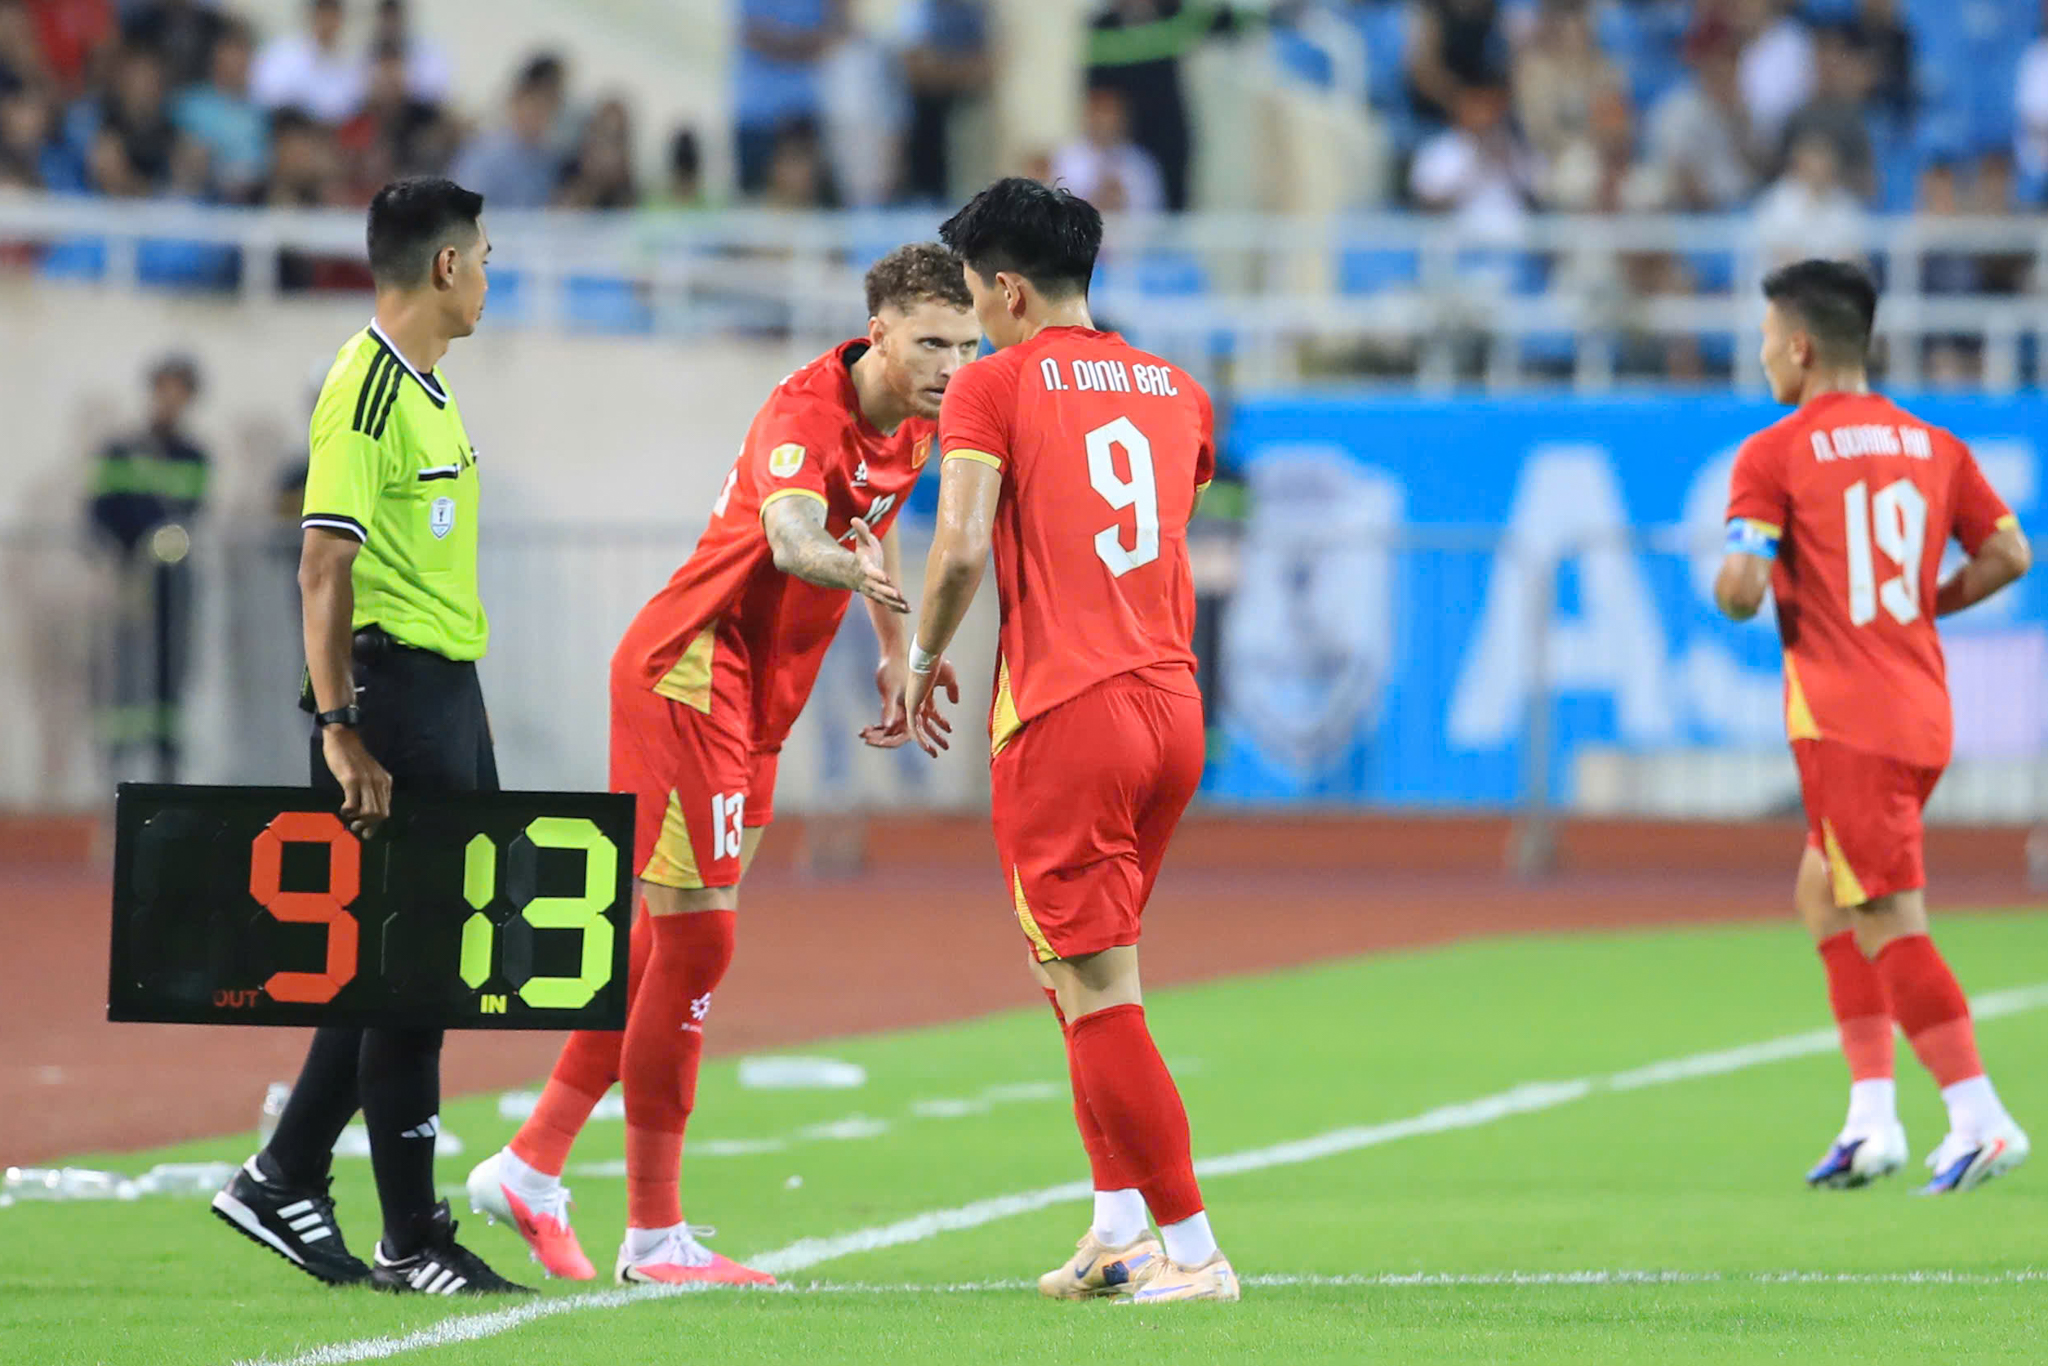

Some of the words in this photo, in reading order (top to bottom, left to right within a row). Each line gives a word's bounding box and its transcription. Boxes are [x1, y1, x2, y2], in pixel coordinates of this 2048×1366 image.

[1071, 359, 1131, 393] DINH
[1131, 363, 1179, 397] BAC
[1083, 415, 1161, 579] 9
[1843, 477, 1928, 628] 19
[711, 792, 745, 861] 13
[249, 811, 361, 1004] 9
[459, 816, 618, 1009] 13
[212, 989, 258, 1008] OUT
[480, 994, 507, 1014] IN
